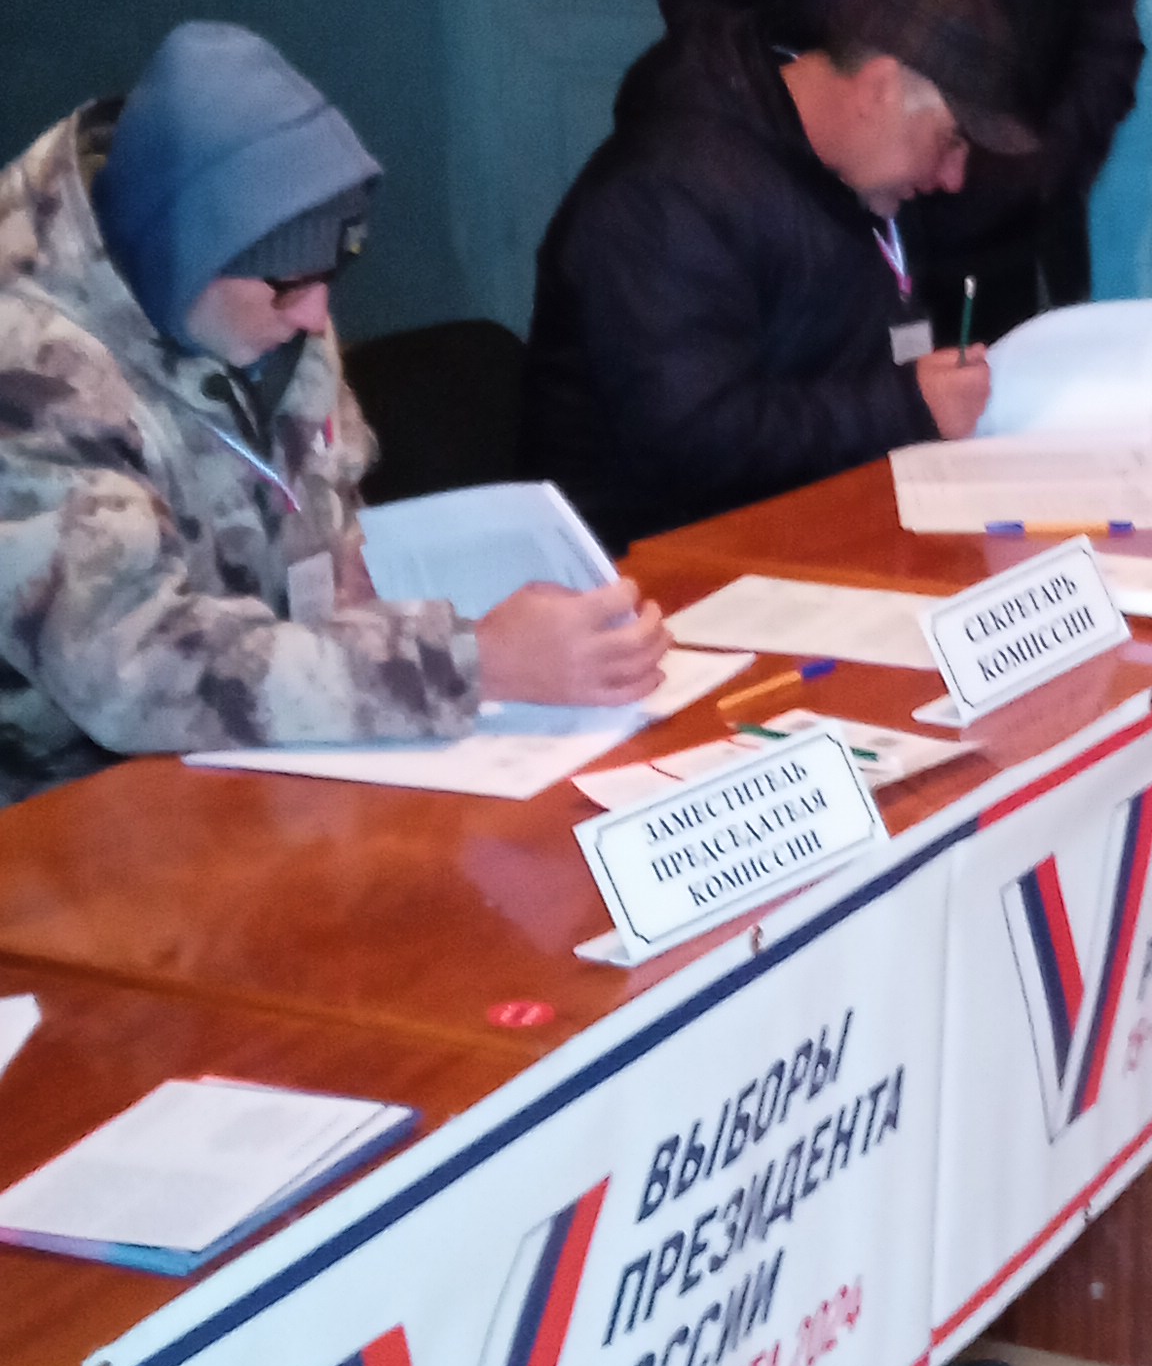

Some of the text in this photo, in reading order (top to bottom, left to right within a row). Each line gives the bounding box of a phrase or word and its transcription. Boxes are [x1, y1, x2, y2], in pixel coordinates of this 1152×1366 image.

[963, 572, 1078, 644] СЕКРЕТАРЬ
[975, 605, 1097, 683] КОМИССИИ
[643, 759, 809, 846] ЗАМЕСТИТЕЛЬ
[650, 788, 829, 884] ПРЕДСЕДАТЕЛЯ
[687, 829, 824, 907] КОМИССИИ
[635, 1007, 854, 1224] ВЫБОРЫ
[602, 1063, 905, 1348] ПРЕЗИДЕНТА
